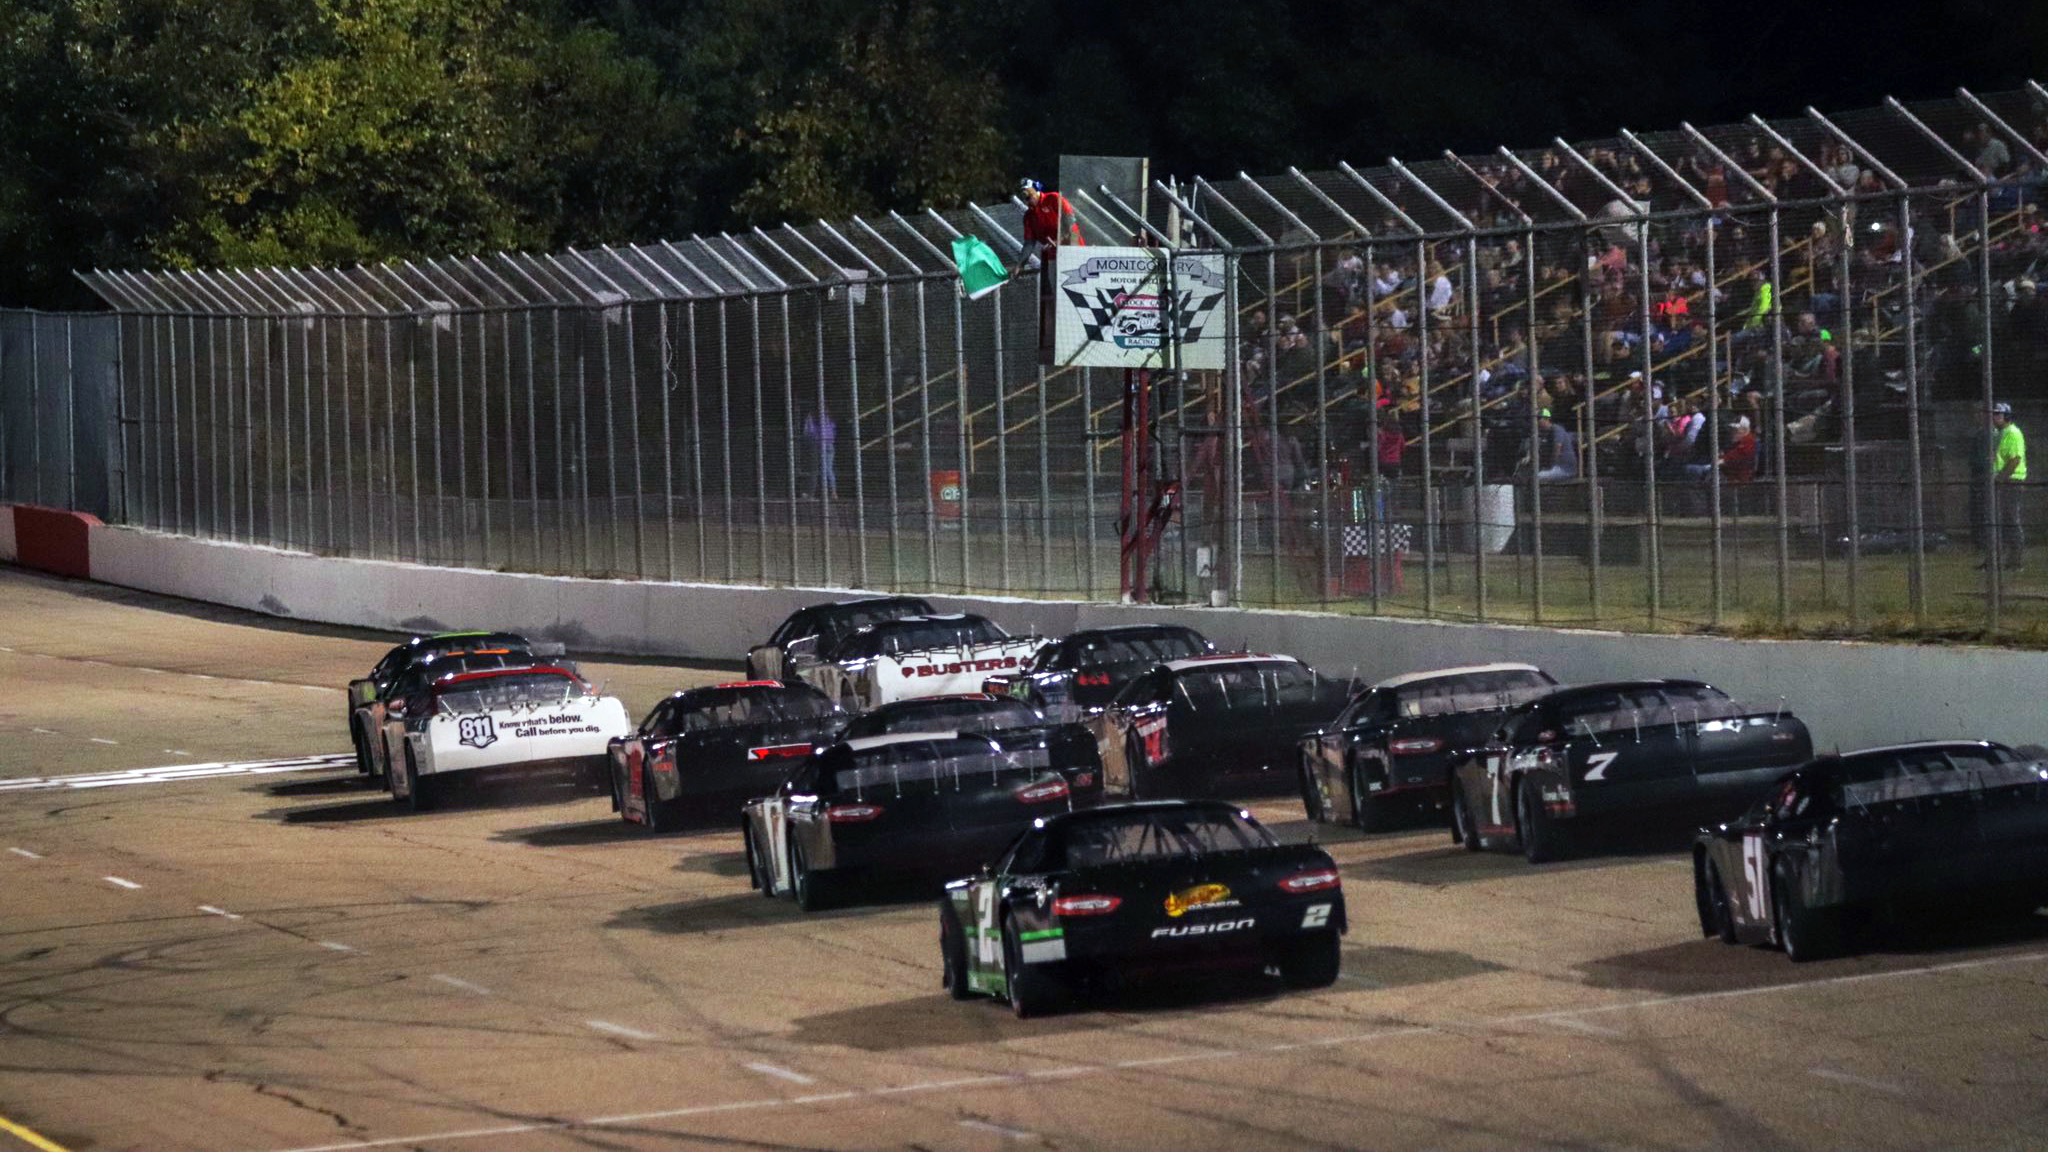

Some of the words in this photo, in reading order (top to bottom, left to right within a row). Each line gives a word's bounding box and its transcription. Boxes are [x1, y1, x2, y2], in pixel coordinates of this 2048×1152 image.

[917, 657, 1017, 677] BUSTERS
[460, 716, 493, 740] 811
[499, 720, 521, 730] Know
[549, 714, 583, 725] below.
[515, 726, 537, 738] Call
[539, 727, 567, 736] before
[568, 727, 585, 735] you
[1583, 752, 1619, 781] 7
[1300, 902, 1333, 929] 2
[1150, 917, 1256, 939] FUSION
